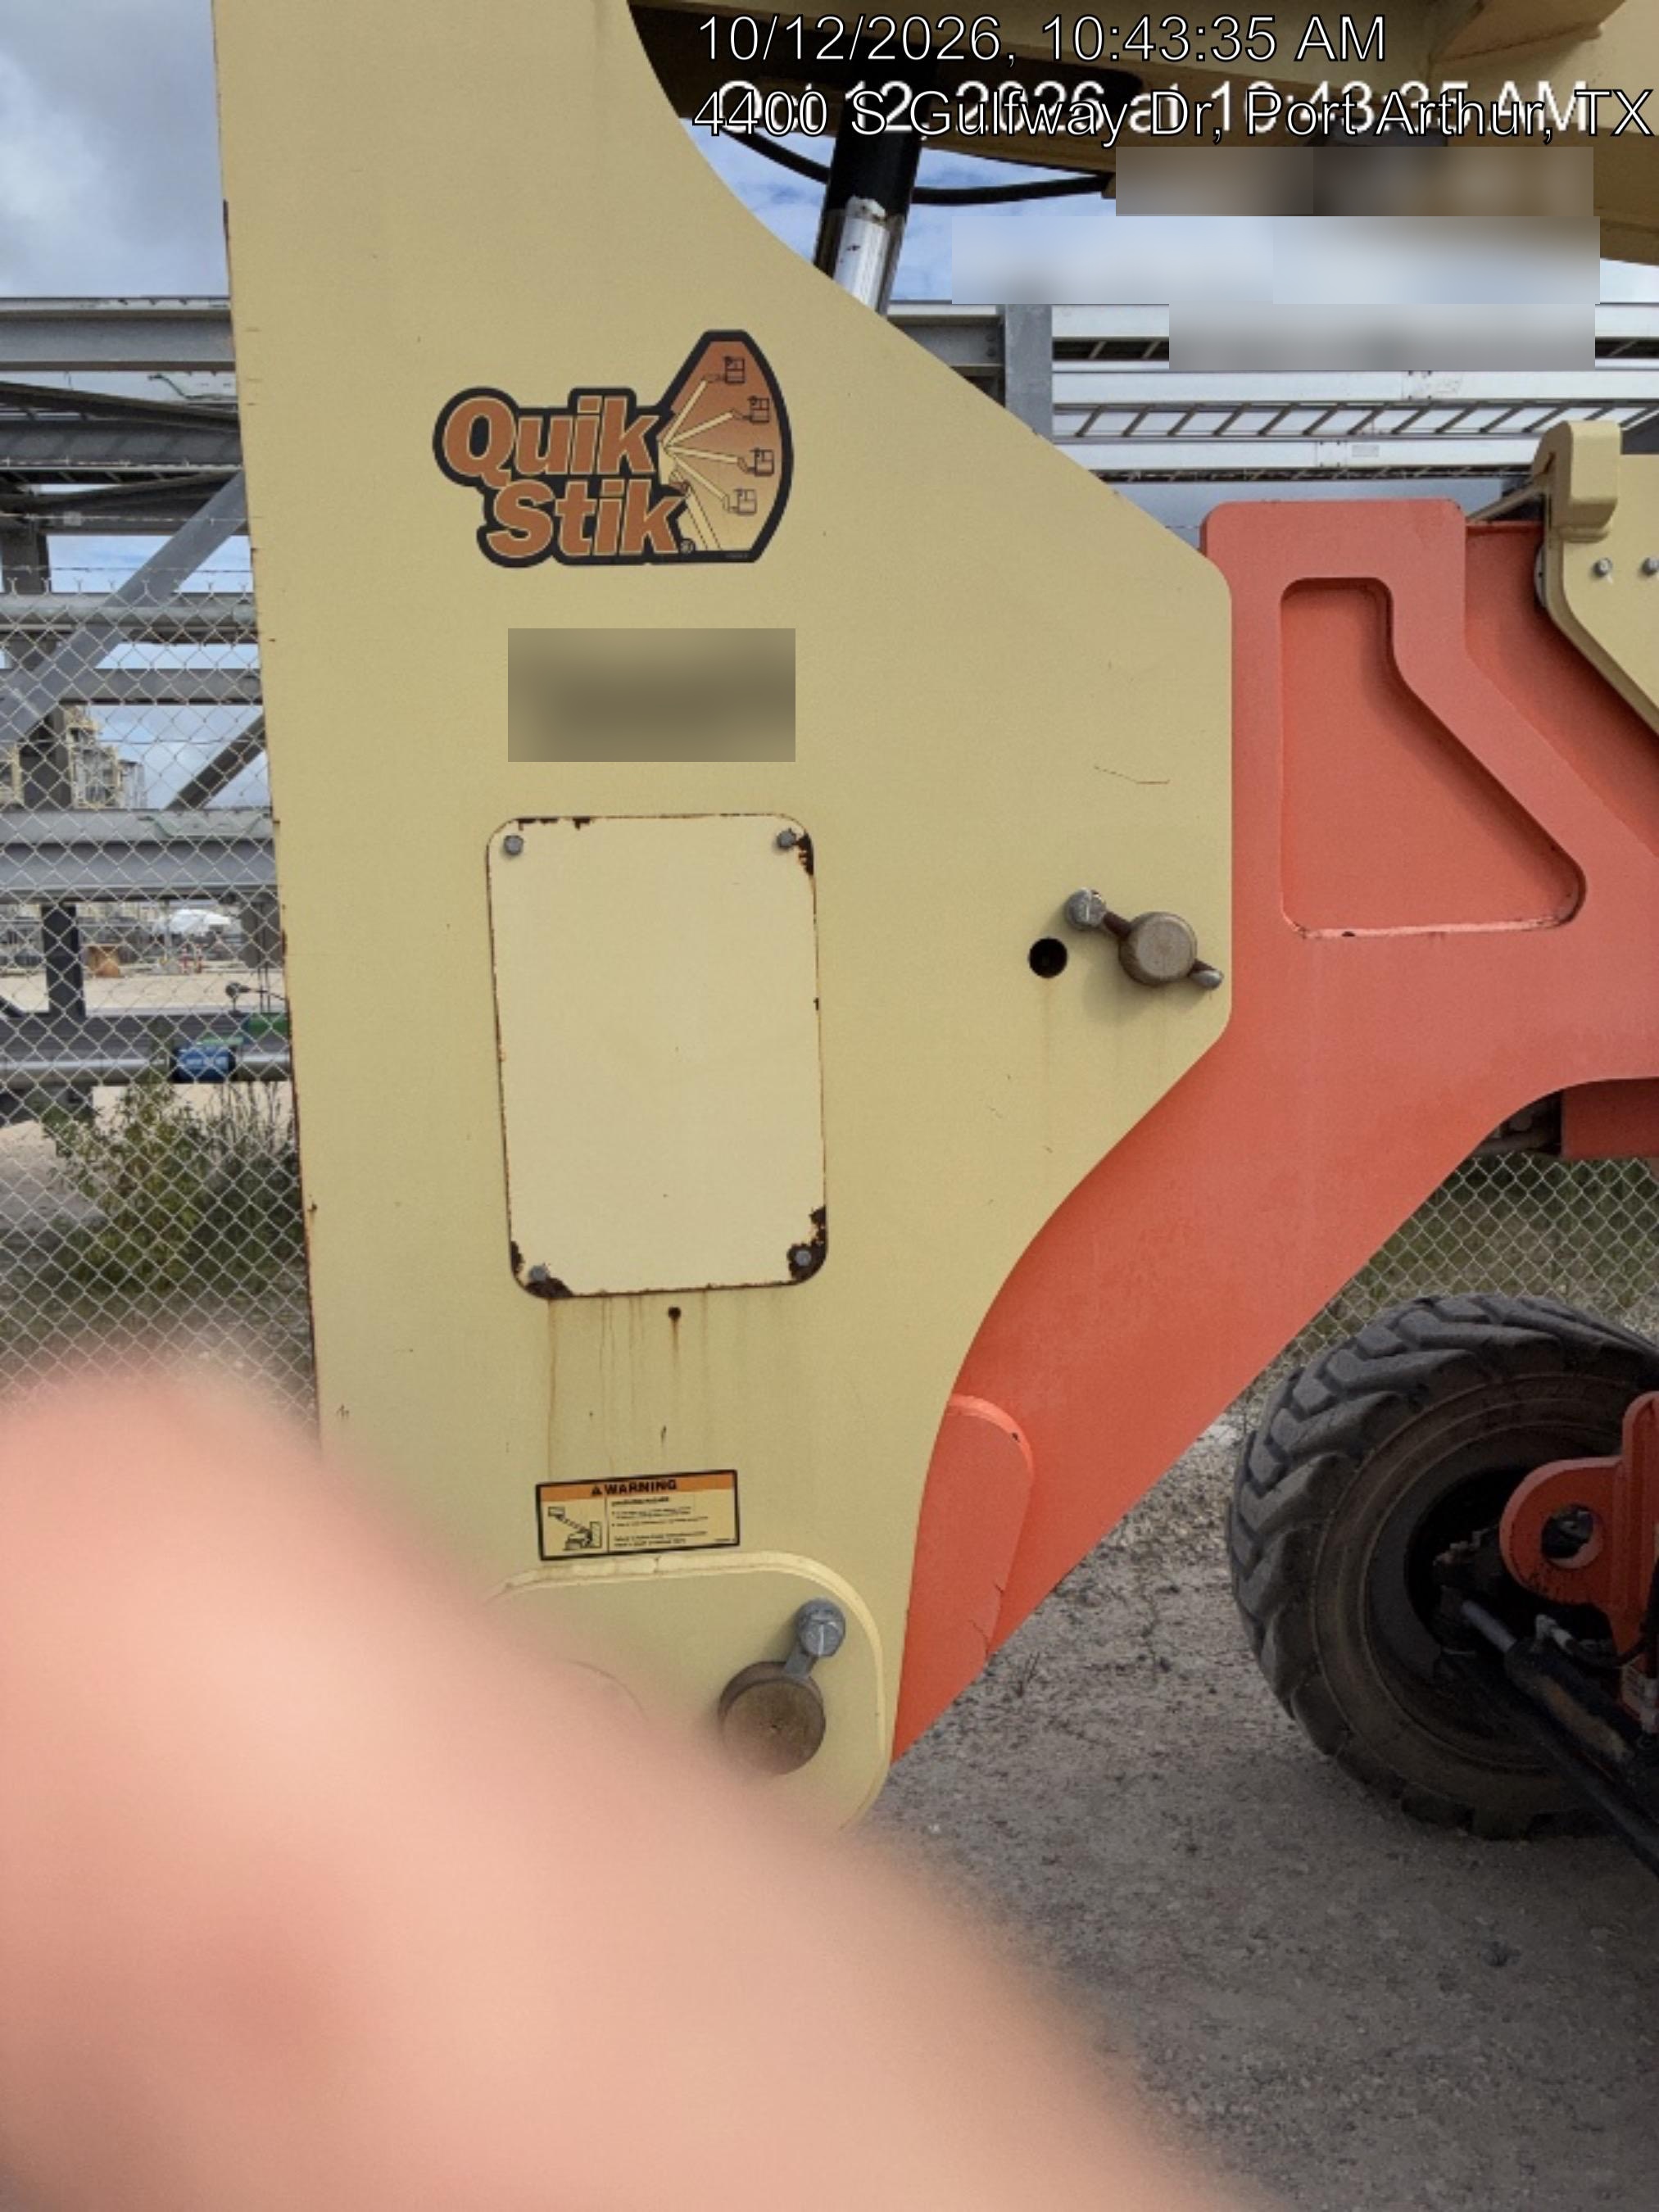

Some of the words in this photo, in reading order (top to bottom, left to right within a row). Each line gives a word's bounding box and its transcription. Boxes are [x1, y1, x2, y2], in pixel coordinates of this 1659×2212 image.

[442, 395, 660, 490] Quik
[486, 478, 690, 558] Stik
[604, 1479, 678, 1496] WARNING
